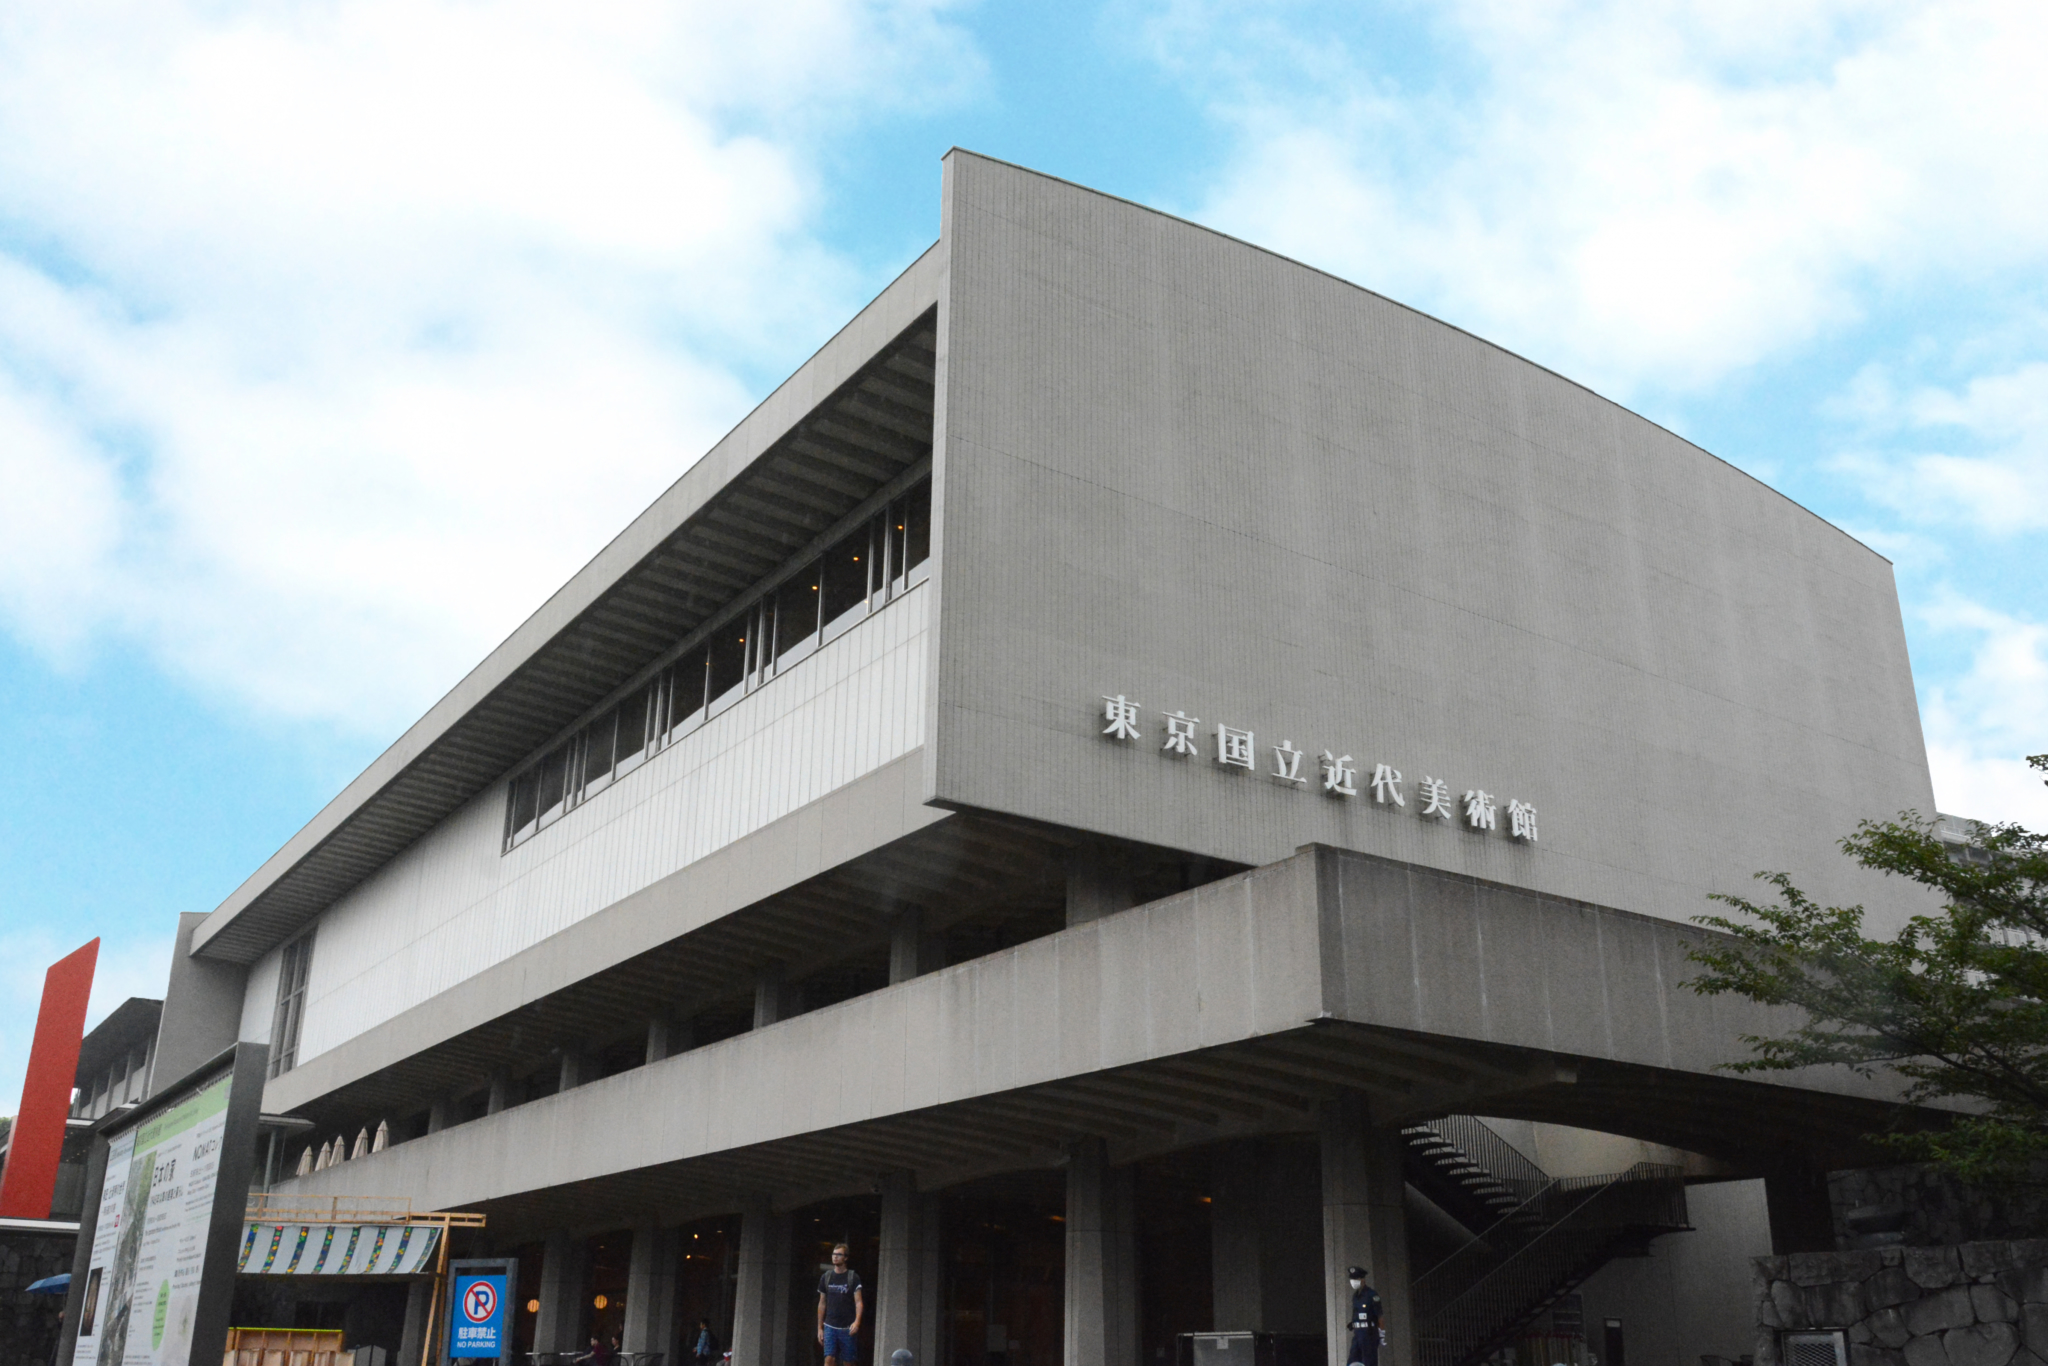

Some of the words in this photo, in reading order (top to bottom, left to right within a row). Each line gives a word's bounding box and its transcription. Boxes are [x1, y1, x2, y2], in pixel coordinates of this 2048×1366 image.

[1102, 695, 1538, 842] 東京国立近代美術館
[458, 1327, 496, 1339] 駐車禁止
